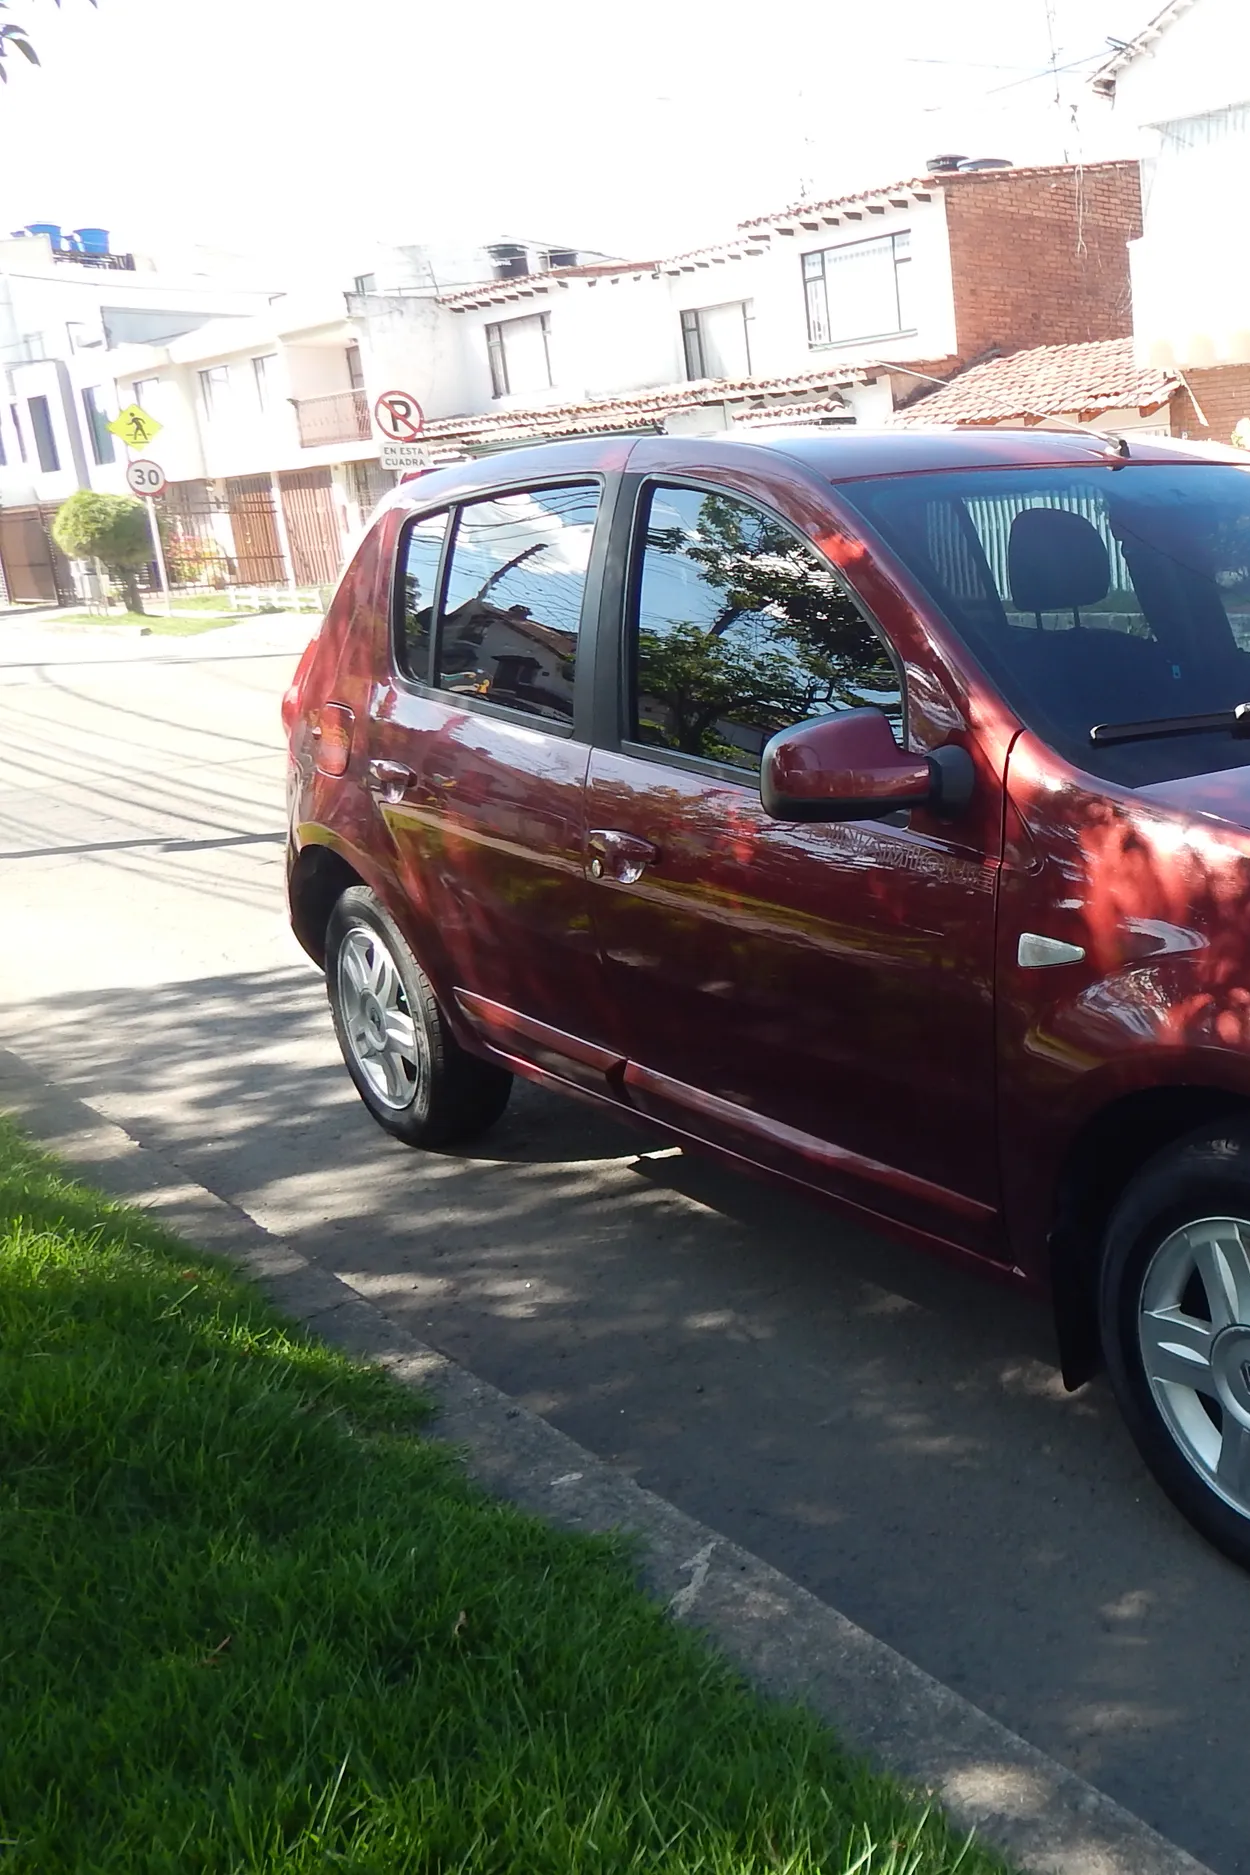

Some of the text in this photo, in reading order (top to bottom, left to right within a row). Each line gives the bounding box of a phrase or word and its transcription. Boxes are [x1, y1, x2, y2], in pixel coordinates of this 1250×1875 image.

[388, 400, 411, 432] P
[383, 447, 424, 455] EN ESTA
[385, 458, 425, 466] CUADRA
[134, 468, 159, 485] 30
